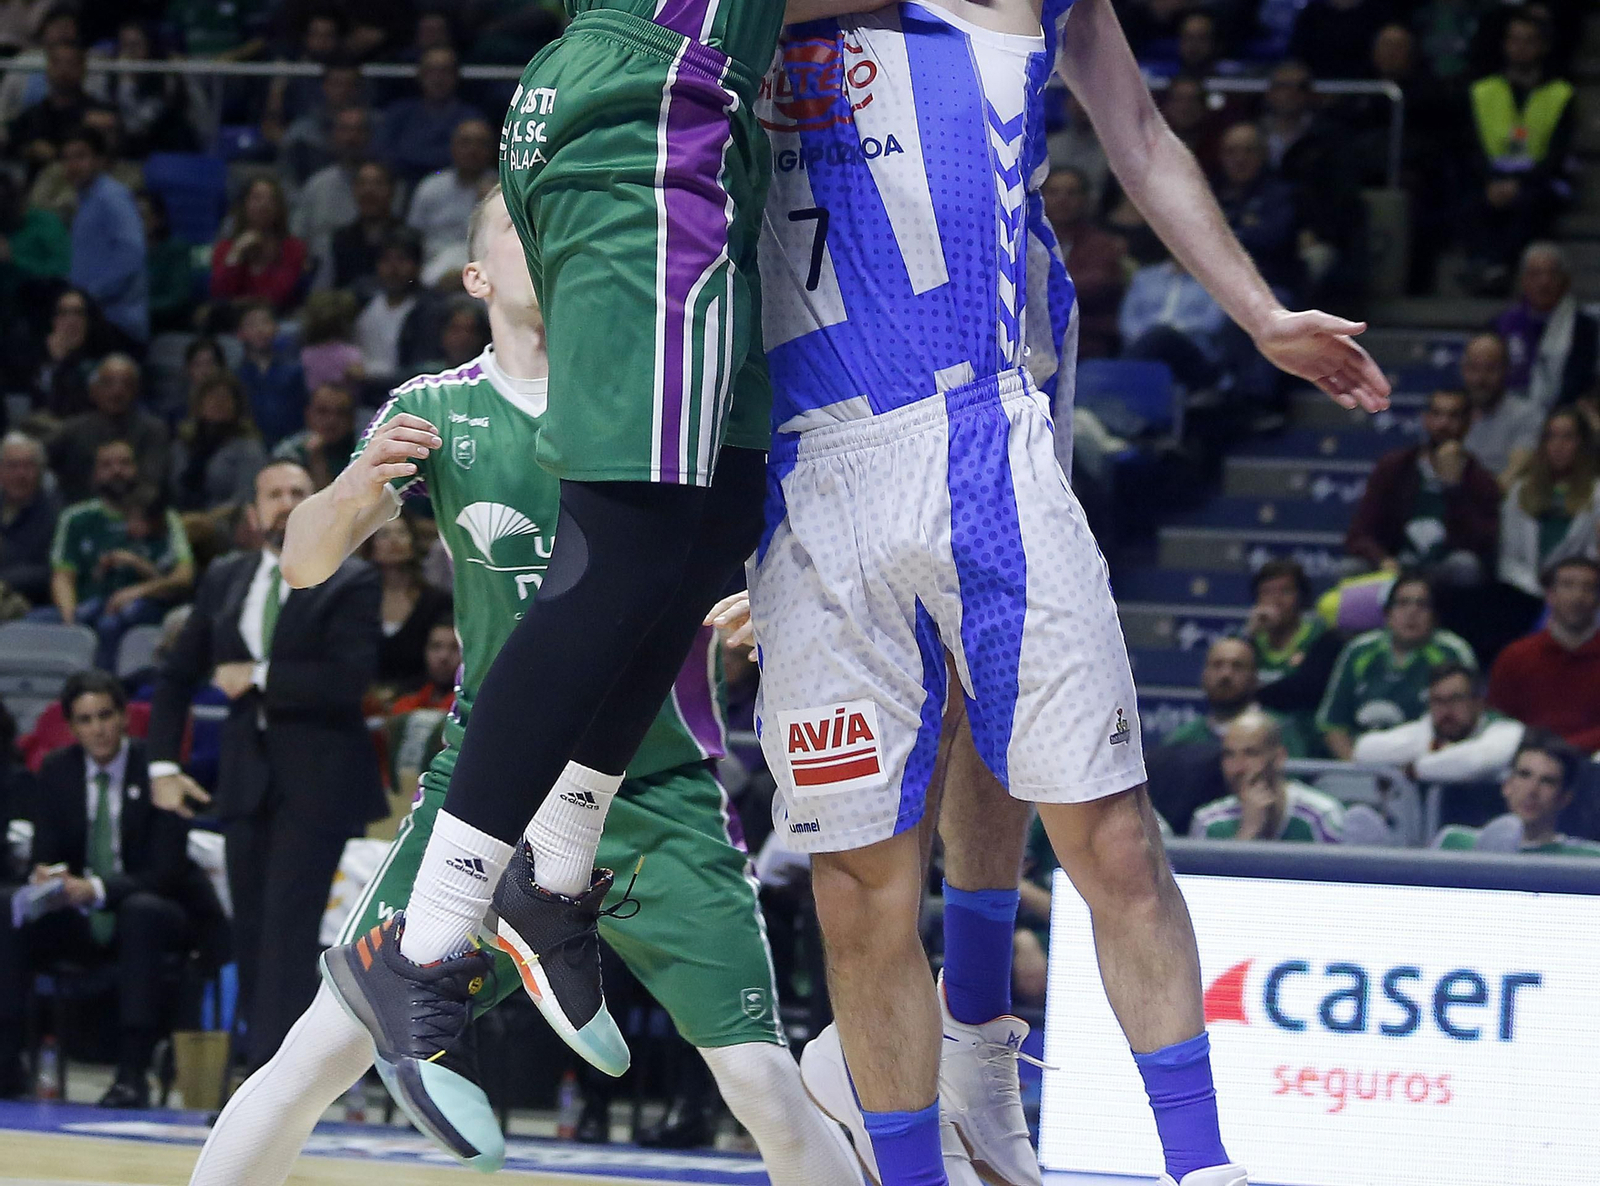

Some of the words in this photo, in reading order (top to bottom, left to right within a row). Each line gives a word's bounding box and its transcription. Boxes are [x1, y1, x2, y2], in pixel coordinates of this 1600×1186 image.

[787, 207, 830, 291] 7
[560, 794, 599, 810] adidas
[789, 818, 820, 834] ummel
[446, 859, 488, 882] adidas
[1264, 958, 1542, 1042] caser
[1273, 1064, 1454, 1113] seguros
